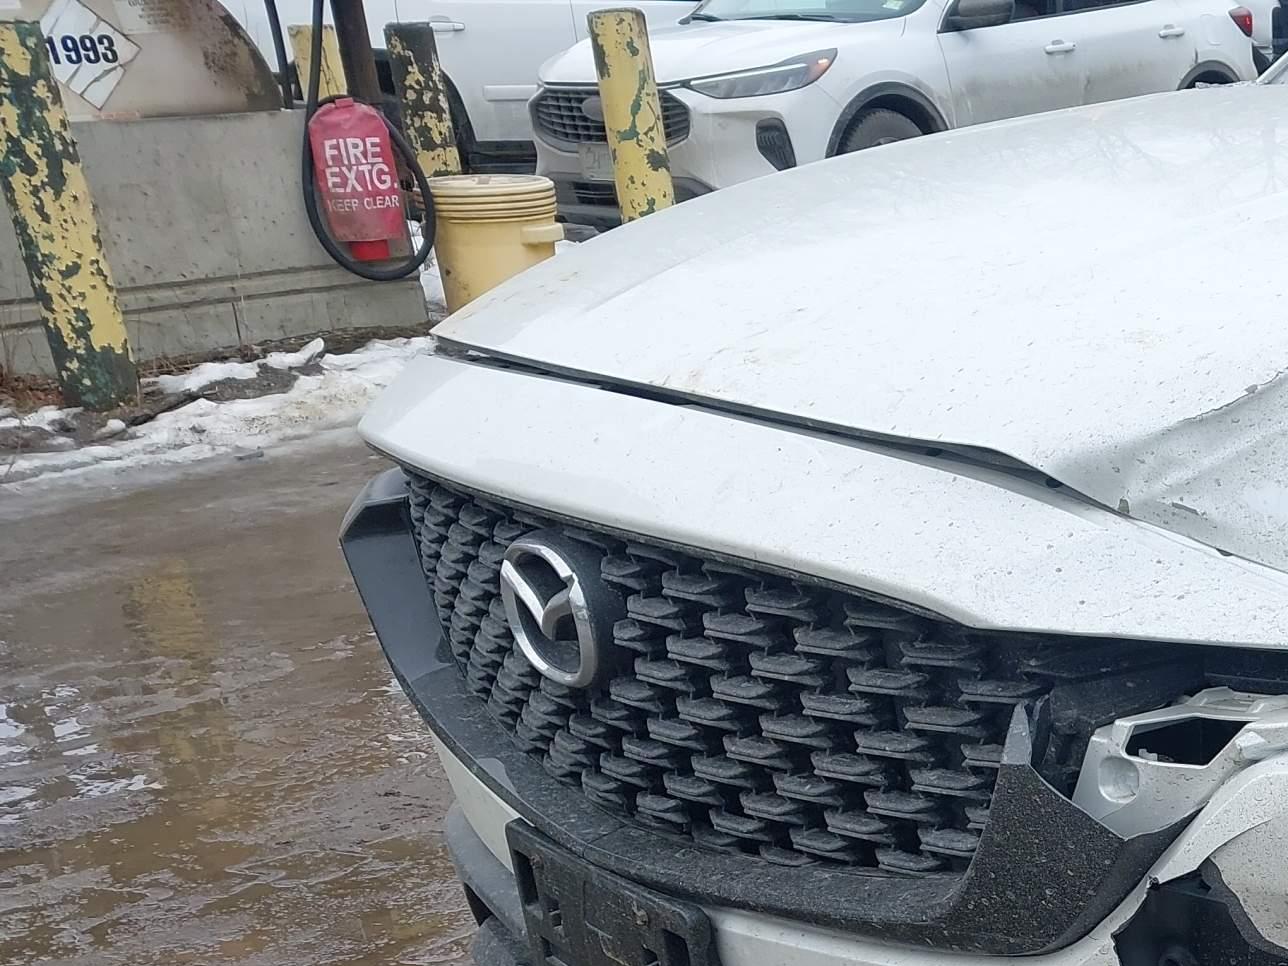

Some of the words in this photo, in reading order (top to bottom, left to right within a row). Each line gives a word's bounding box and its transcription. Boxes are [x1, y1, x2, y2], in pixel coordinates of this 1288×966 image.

[46, 34, 119, 64] 1993
[324, 137, 383, 166] FIRE
[325, 163, 398, 193] EXTG.
[327, 198, 359, 212] KEEP
[364, 195, 400, 210] CLEAR
